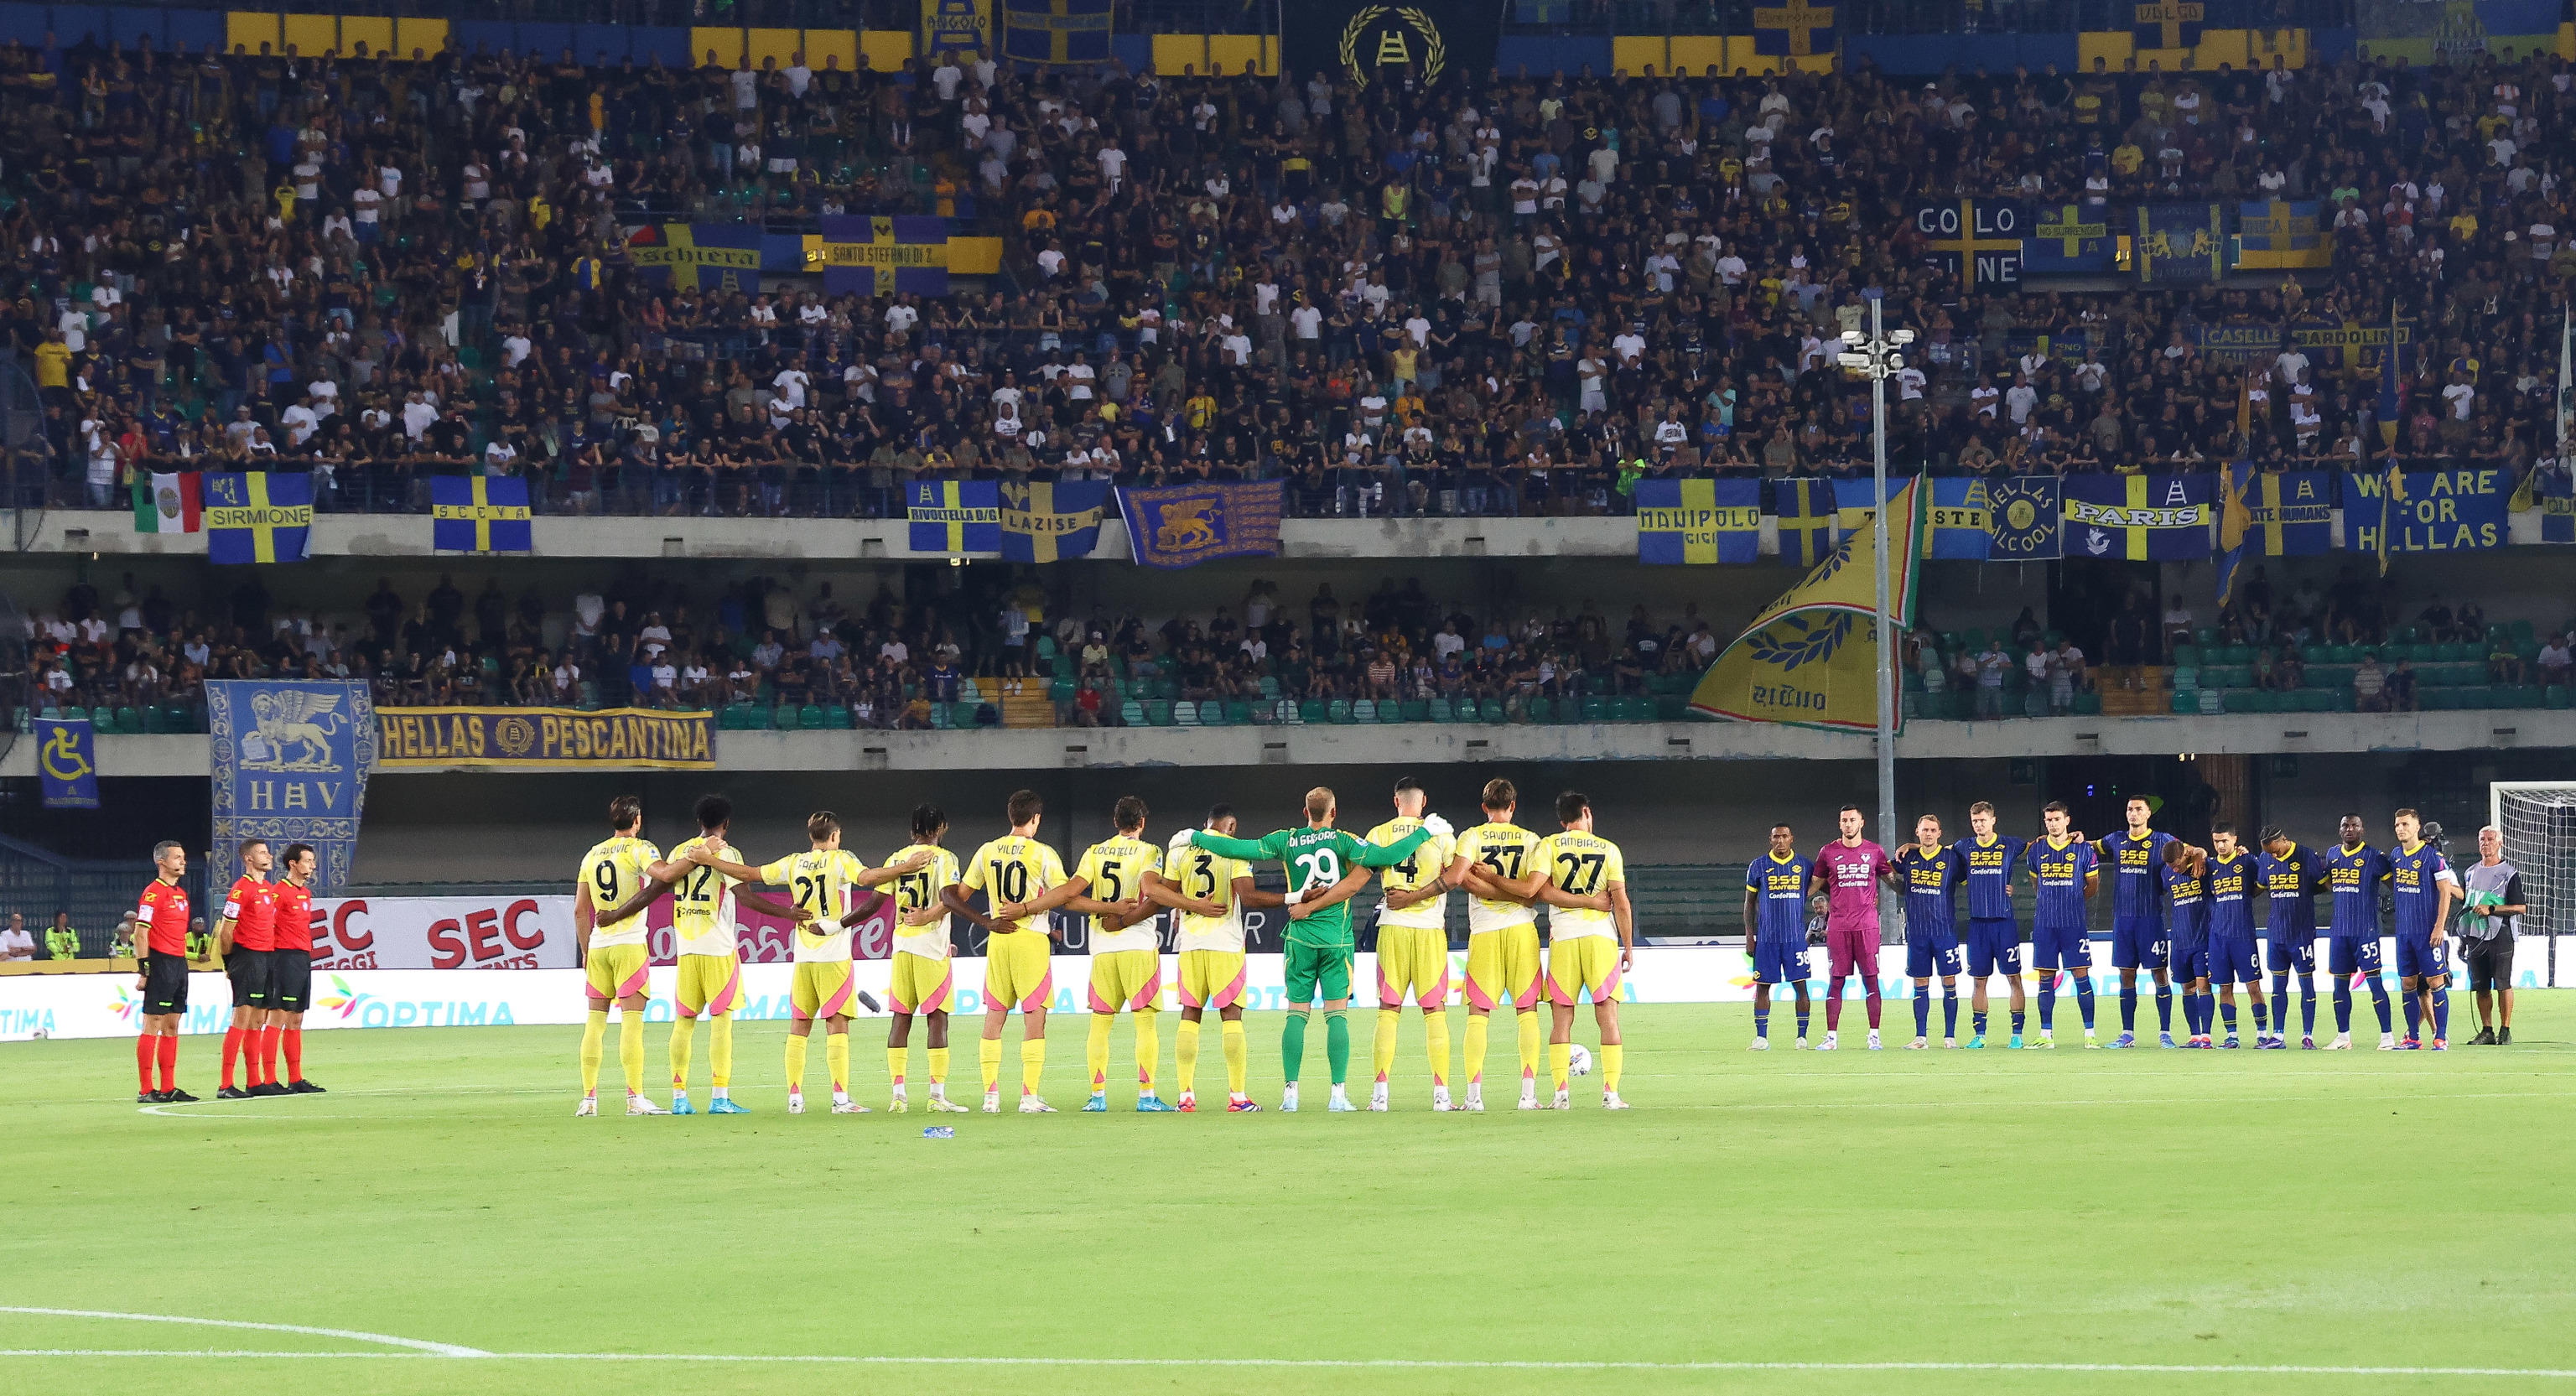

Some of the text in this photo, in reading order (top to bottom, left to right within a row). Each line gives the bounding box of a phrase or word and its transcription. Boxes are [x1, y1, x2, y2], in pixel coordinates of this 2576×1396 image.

[834, 247, 865, 262] SANTO
[867, 247, 910, 262] STEFANO
[2208, 328, 2281, 344] CASELLE
[2430, 470, 2498, 497] ARE
[213, 508, 310, 526] SIRMIONE
[911, 508, 974, 522] RIVOLTELLA
[1009, 517, 1078, 532] LAZISE
[1640, 509, 1759, 528] MANIPOLO
[2075, 501, 2199, 527] PARIS
[2358, 522, 2497, 552] HLLAS
[381, 715, 711, 760] HELLAS PESCANTINA
[1289, 837, 1299, 848] DI
[1482, 830, 1522, 841] SAVONA
[1554, 837, 1607, 850] CAMBIASO
[997, 845, 1026, 855] YILDIZ
[1093, 846, 1138, 857] LOCATELLI
[1294, 847, 1341, 892] 29
[1393, 851, 1418, 884] 4
[1480, 844, 1525, 880] 37
[596, 859, 619, 902] 9
[990, 859, 1028, 904] 10
[1101, 860, 1122, 903] 5
[1194, 854, 1216, 899] 3
[1555, 852, 1607, 895] 27
[1910, 878, 1941, 887] SANTERO
[794, 874, 829, 917] 21
[898, 872, 929, 914] 51
[308, 899, 374, 962] EC
[427, 898, 545, 970] SEC
[1795, 951, 1810, 967] 38
[2151, 940, 2167, 956] 42
[2298, 944, 2314, 961] 14
[2361, 941, 2379, 960] 35
[2432, 947, 2443, 963] 8
[2251, 953, 2260, 968] 6
[0, 1008, 55, 1035] TIMA
[361, 1001, 514, 1029] OPTIMA
